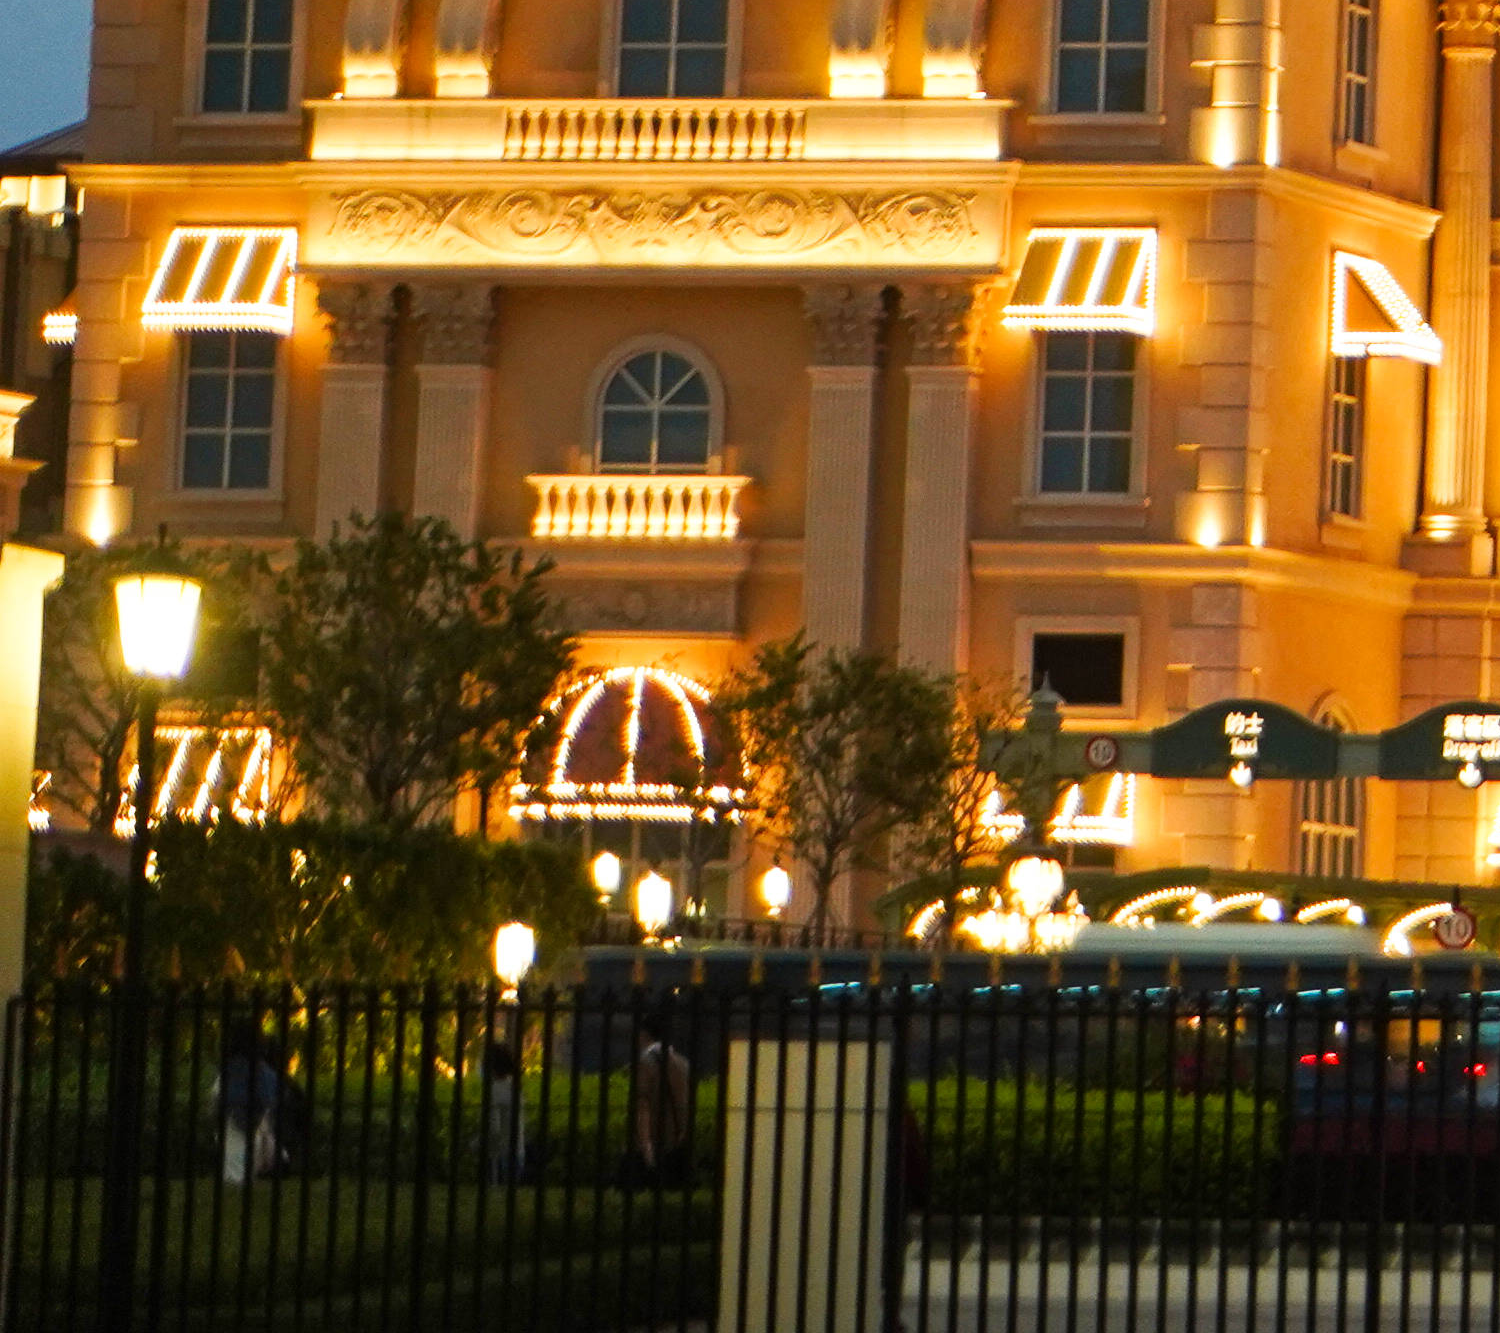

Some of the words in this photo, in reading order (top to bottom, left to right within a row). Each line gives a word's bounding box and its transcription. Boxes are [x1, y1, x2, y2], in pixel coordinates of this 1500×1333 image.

[1225, 711, 1265, 735] 的士
[1230, 736, 1260, 757] Taxi
[1443, 917, 1470, 939] 10
